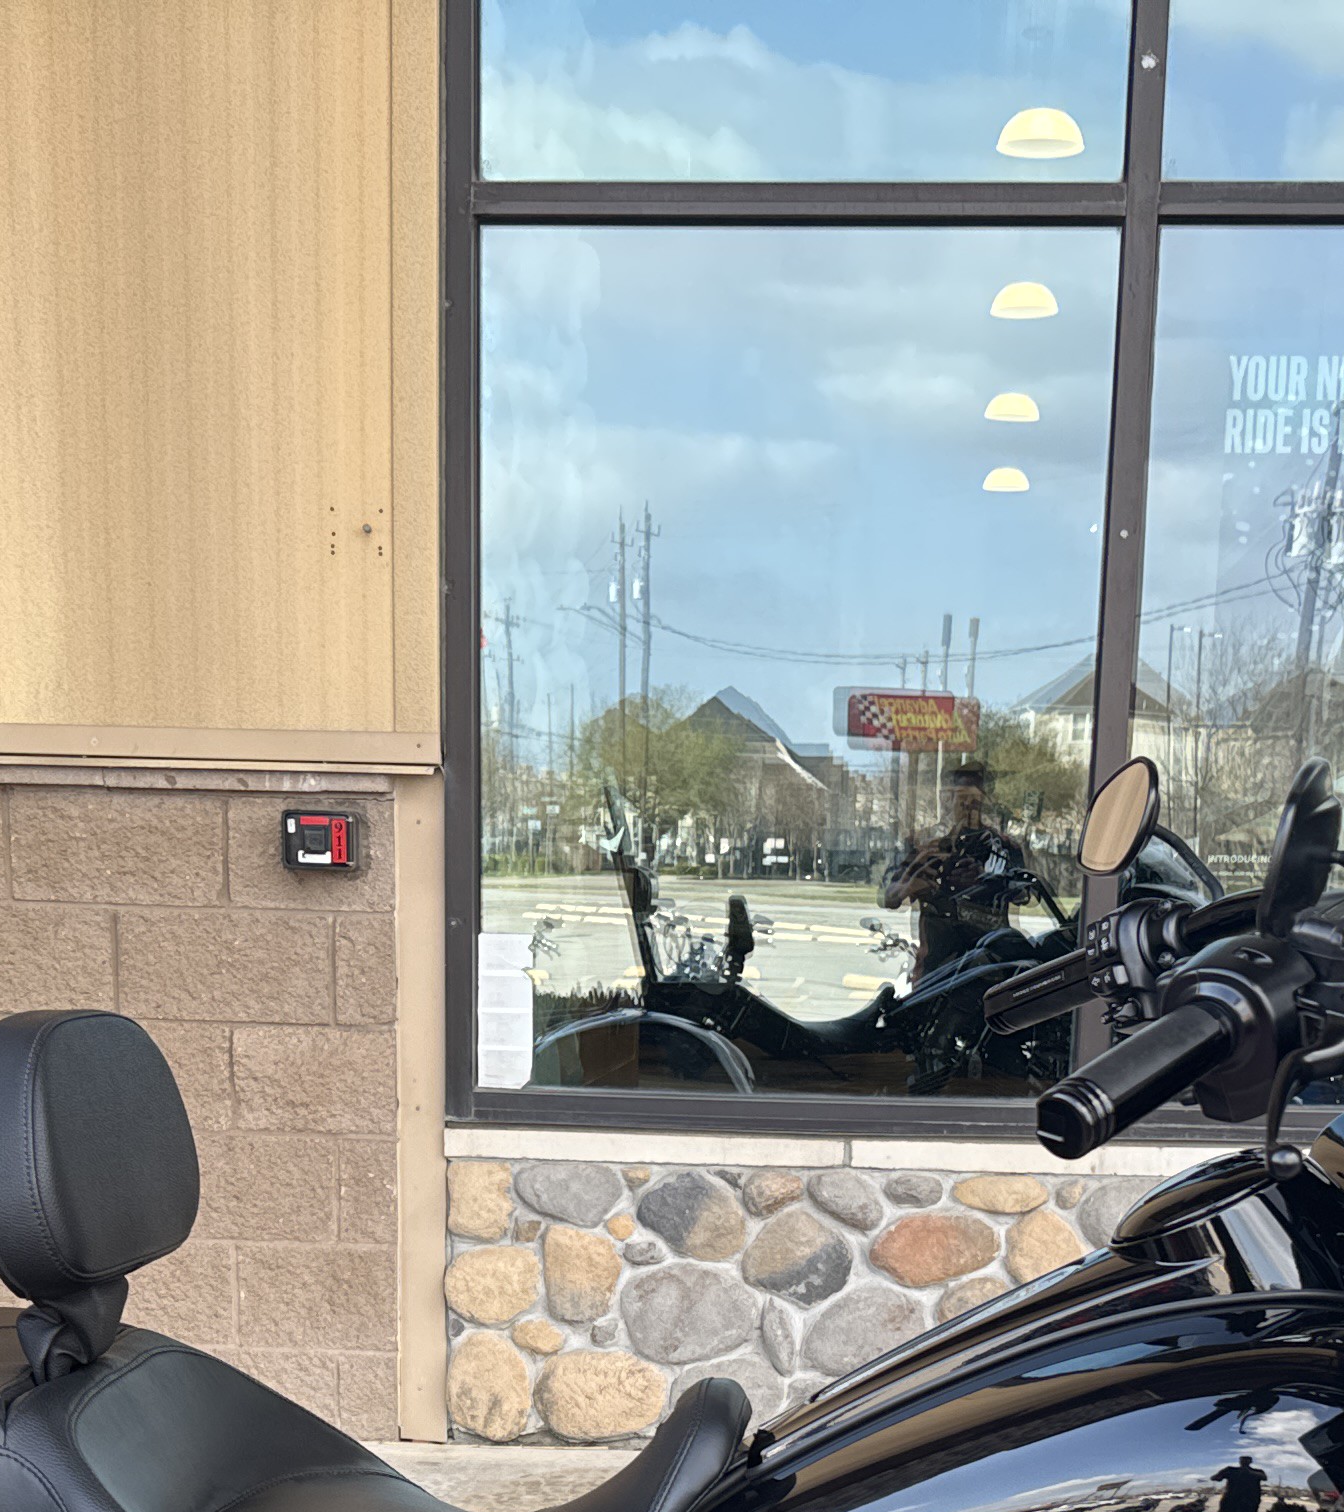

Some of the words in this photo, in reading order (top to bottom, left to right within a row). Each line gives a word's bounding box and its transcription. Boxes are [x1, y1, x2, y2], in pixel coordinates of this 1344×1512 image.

[1229, 355, 1308, 401] YOUR
[1224, 408, 1294, 454] RIDE
[1301, 408, 1331, 454] IS
